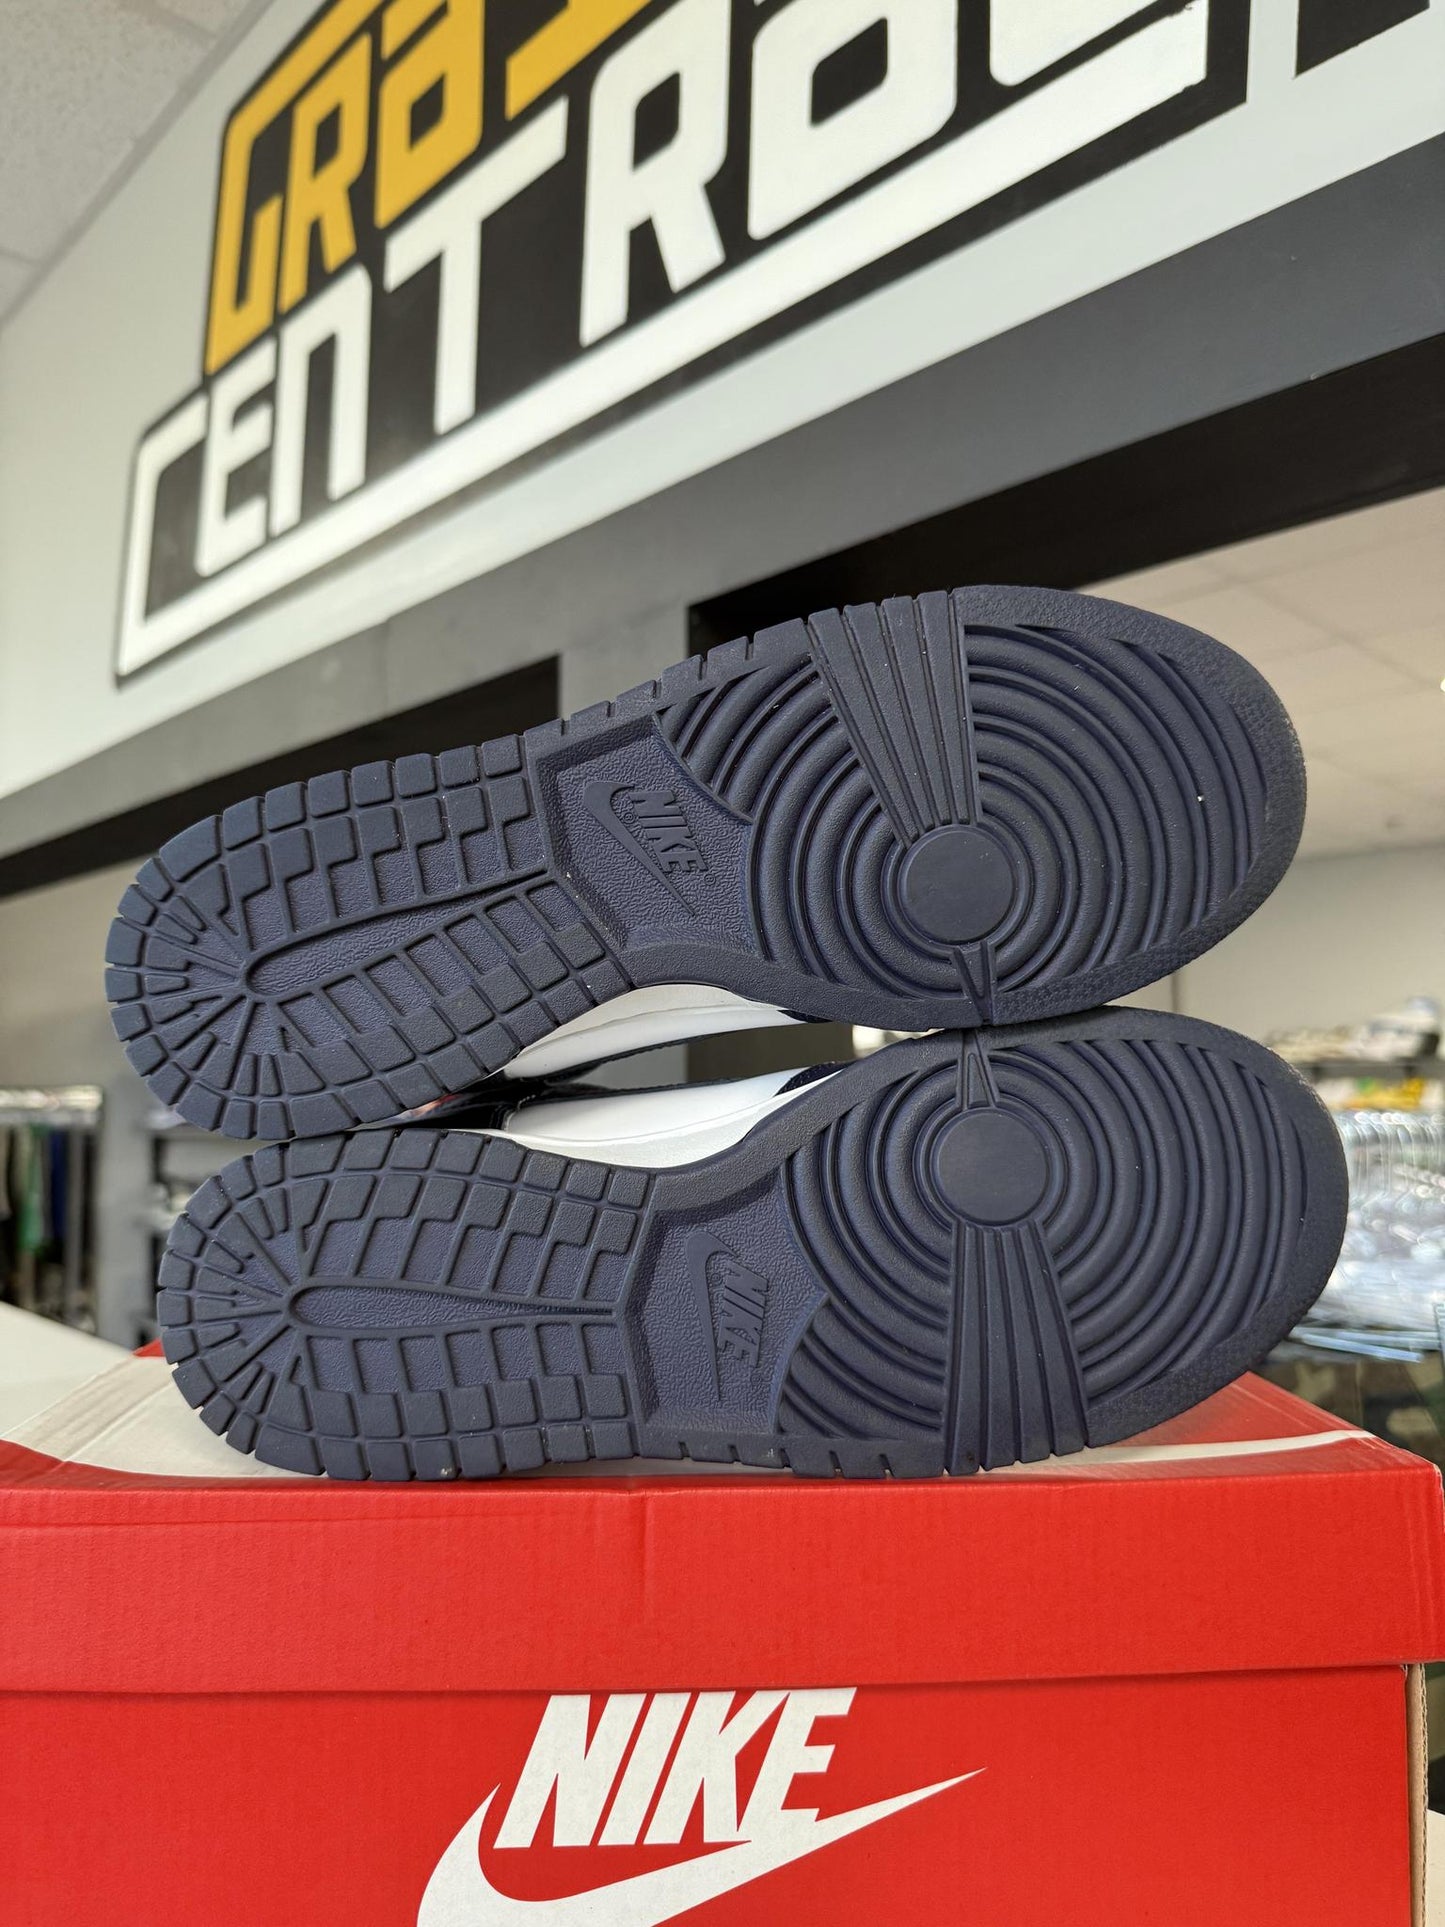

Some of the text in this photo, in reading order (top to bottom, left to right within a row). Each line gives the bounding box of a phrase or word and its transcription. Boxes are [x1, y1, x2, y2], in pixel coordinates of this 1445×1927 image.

[627, 789, 709, 874] NIKE
[716, 1259, 770, 1369] NIKE
[493, 1686, 857, 1849] NIKE
